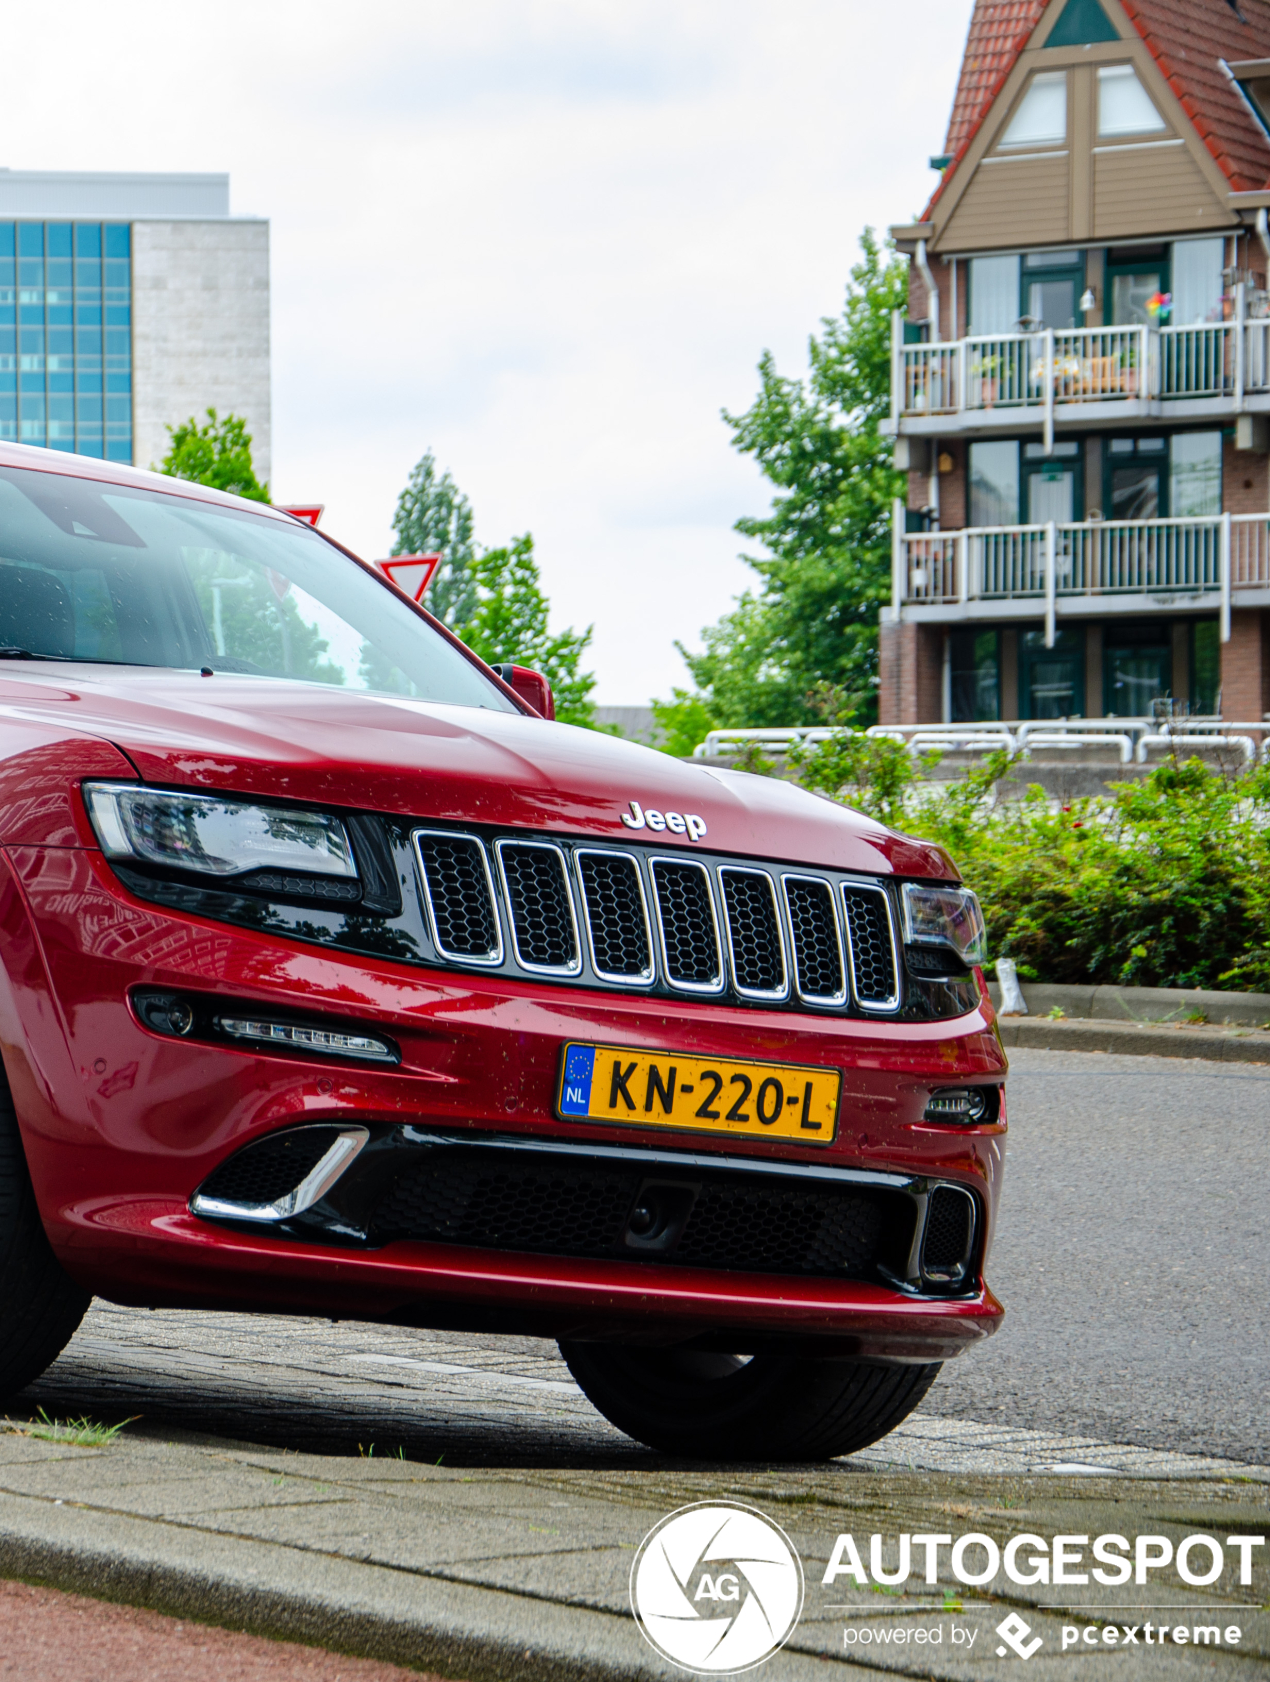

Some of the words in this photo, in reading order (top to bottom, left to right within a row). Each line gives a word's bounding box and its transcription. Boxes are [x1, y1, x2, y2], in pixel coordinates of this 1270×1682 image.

[620, 801, 707, 842] Jeep
[566, 1087, 586, 1104] NL
[609, 1060, 822, 1130] KN-220-L
